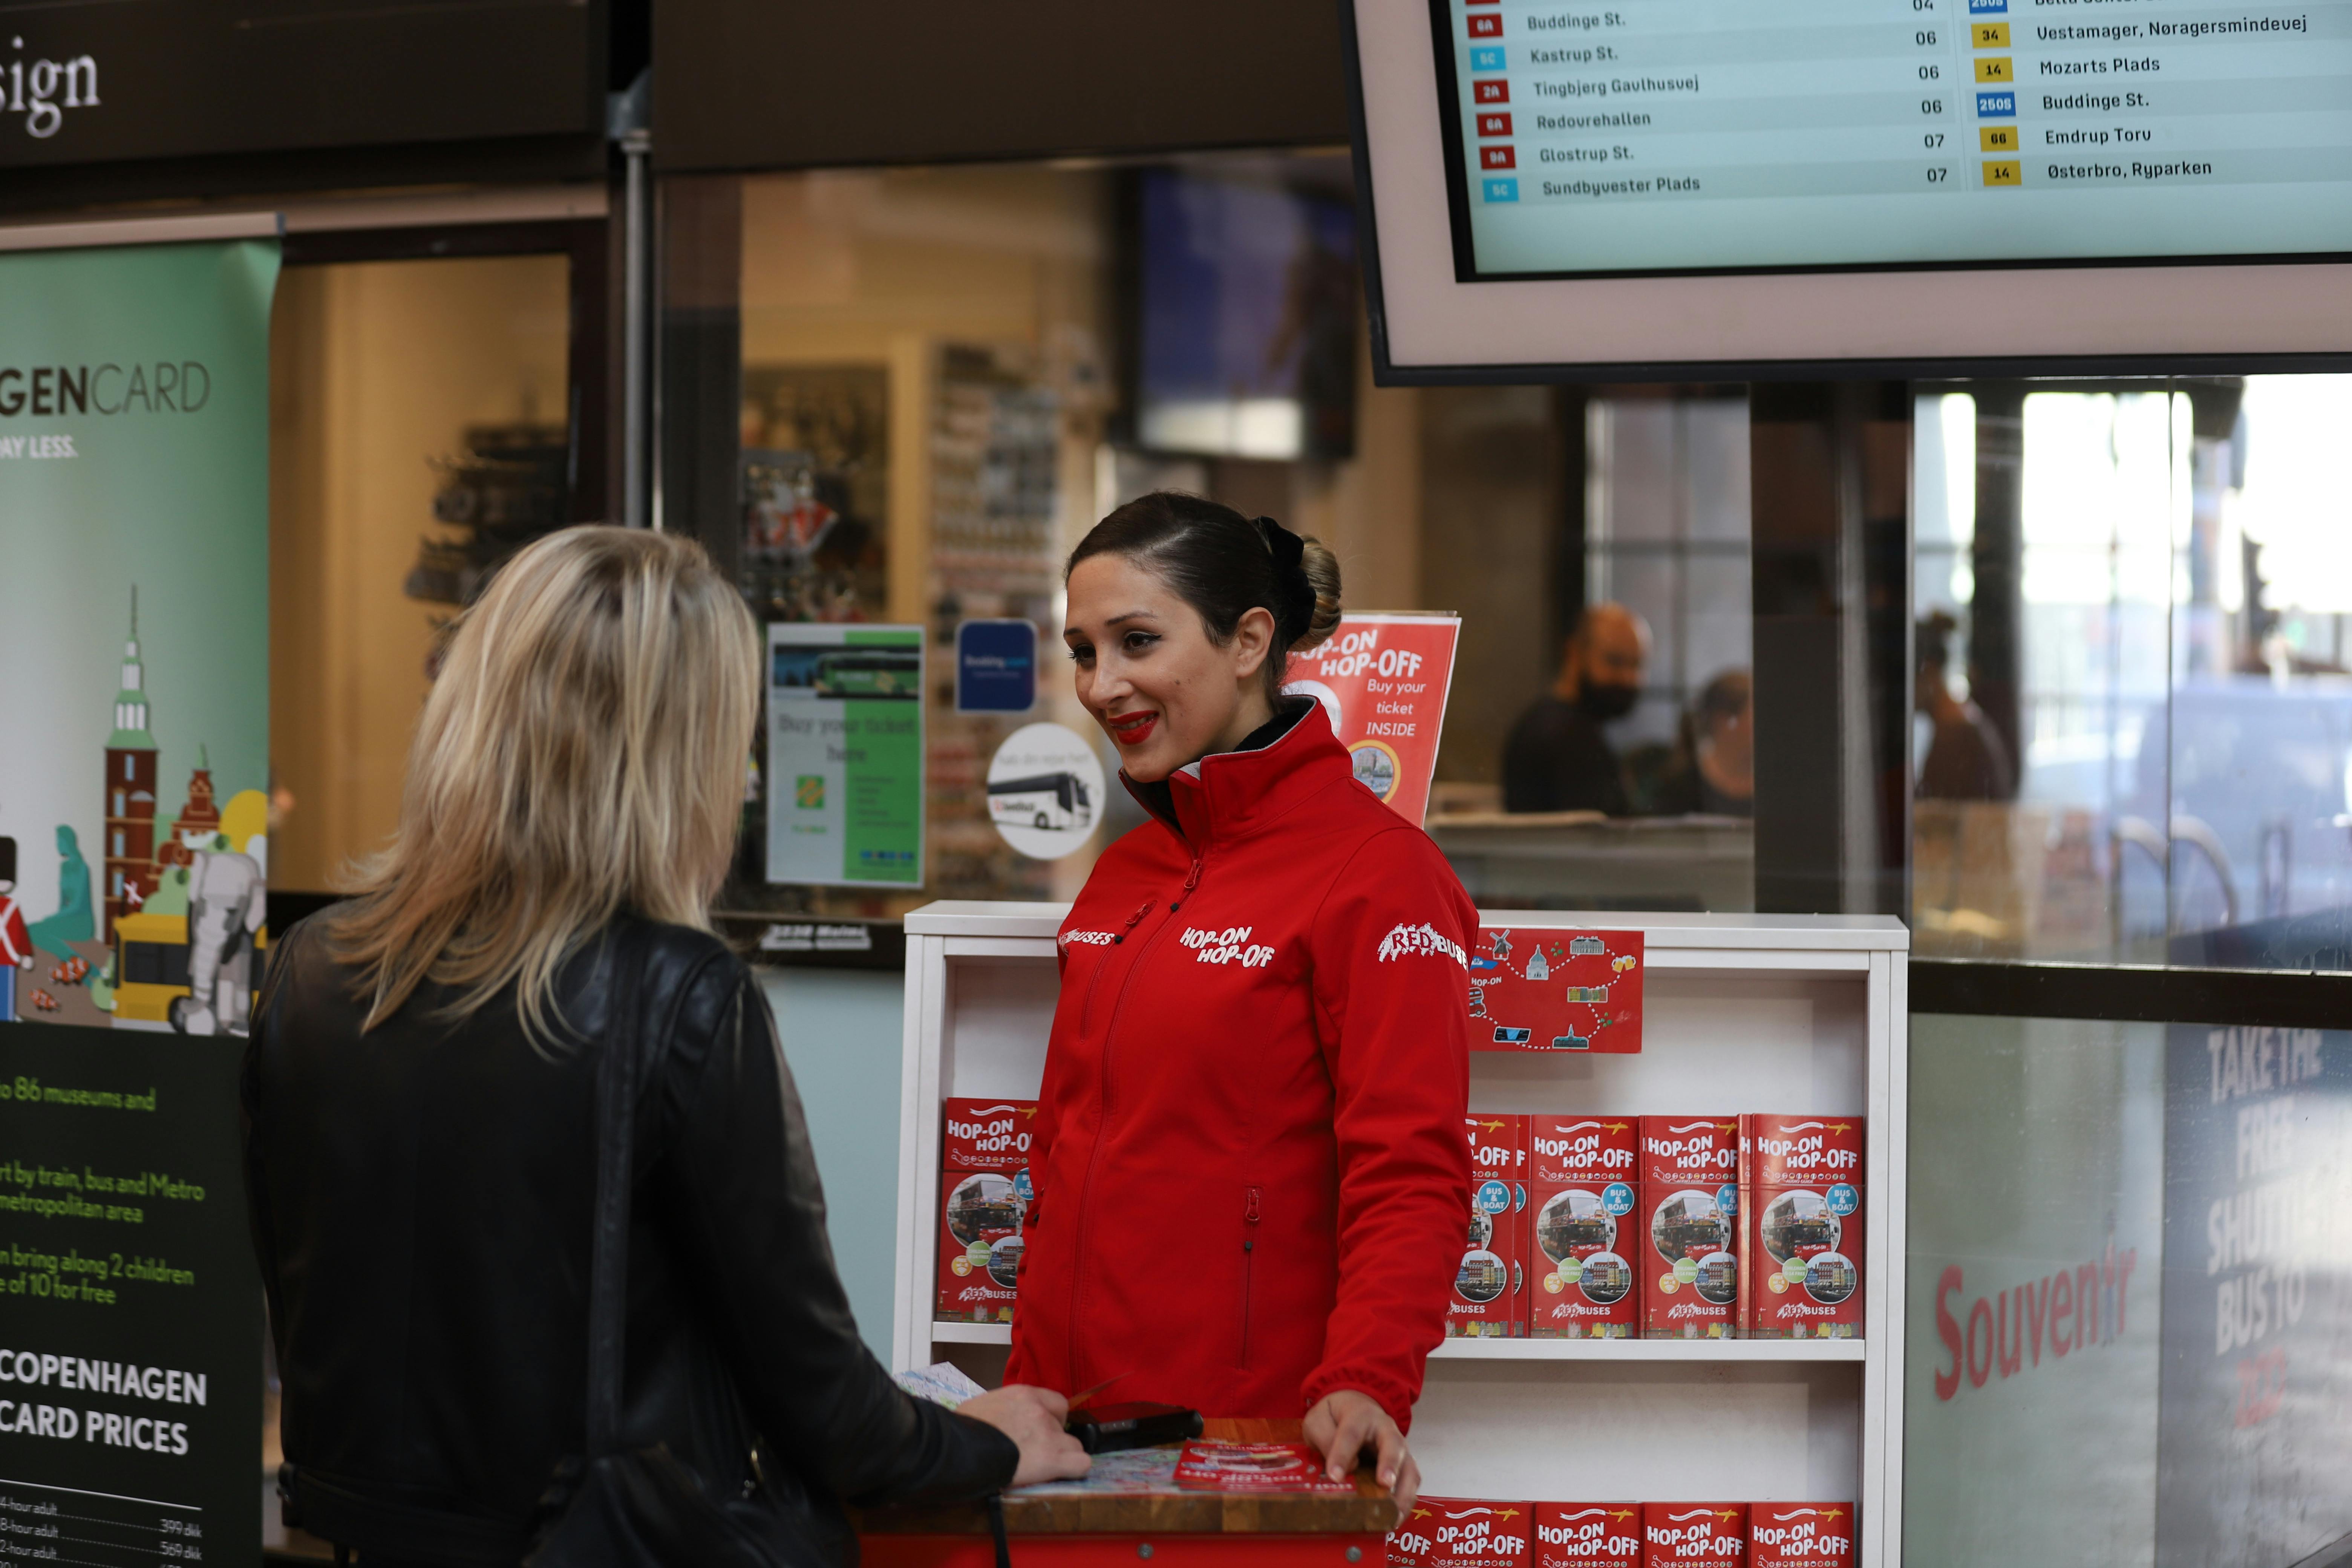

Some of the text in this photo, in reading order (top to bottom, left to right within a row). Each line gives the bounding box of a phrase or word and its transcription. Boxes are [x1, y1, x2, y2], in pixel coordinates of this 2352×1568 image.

[1527, 12, 1626, 31] Buddinge St.
[2037, 15, 2307, 40] Vestamager, Nøragersmindevej
[1916, 32, 1936, 45] 06
[1982, 30, 1998, 41] 34
[1480, 52, 1496, 65] 5C
[1531, 46, 1618, 63] Kastrup St.
[1919, 66, 1939, 80] 06
[1986, 64, 2001, 75] 14
[2041, 57, 2160, 75] Mozarts Plads
[1483, 85, 1500, 98] 2A
[1533, 80, 1606, 97] Tingbjerg
[1922, 100, 1942, 113] 06
[1980, 98, 2012, 112] 250S
[2043, 93, 2150, 111] Buddinge St.
[1924, 134, 1944, 148] 07
[1991, 133, 2007, 144] 66
[2046, 128, 2151, 145] Emdrup Torv
[1540, 145, 1634, 162] Glostrup St.
[1927, 168, 1947, 182] 07
[1994, 167, 2009, 179] 14
[2048, 161, 2212, 179] Østerbro, Ryparken
[1492, 184, 1508, 196] 5C
[1543, 176, 1700, 196] Sundbyvester Plads
[1320, 649, 1423, 677] HOP-OFF
[1367, 679, 1427, 695] Buy your
[1376, 701, 1414, 715] ticket
[1366, 722, 1417, 737] INSIDE
[1179, 926, 1253, 949] HOP-ON
[1196, 944, 1276, 968] HOP-OFF
[1436, 935, 1468, 973] BUSE
[1471, 976, 1502, 987] HOP-ON
[2207, 1026, 2323, 1104] TAKE THE
[14, 1076, 156, 1112] 86 museums and
[947, 1118, 1014, 1139] HOP-ON
[976, 1132, 1032, 1152] HOP-O
[1534, 1134, 1600, 1156] HOP-ON
[1648, 1134, 1713, 1157] HOP-ON
[1758, 1135, 1822, 1156] HOP-ON
[1563, 1148, 1634, 1168] HOP-OFF
[1787, 1148, 1857, 1168] HOP-OFF
[14, 1159, 36, 1189] by
[38, 1165, 83, 1192] train,
[84, 1165, 114, 1192] bus
[116, 1172, 147, 1195] and
[149, 1172, 205, 1201] Metro
[106, 1205, 144, 1223] area
[12, 1243, 58, 1275] bring
[60, 1248, 109, 1281] along
[110, 1253, 124, 1277] 2
[124, 1255, 195, 1286] children
[8, 1271, 26, 1295] of
[28, 1272, 52, 1297] 10
[53, 1275, 79, 1300] for
[80, 1277, 117, 1305] free
[986, 1291, 1017, 1299] BUSES
[1454, 1305, 1485, 1314] BUSES
[1579, 1307, 1611, 1315] BUSES
[1695, 1307, 1726, 1315] BUSES
[1805, 1307, 1836, 1315] BUSES
[2216, 1265, 2269, 1356] BUS
[0, 1349, 207, 1406] COPENHAGEN
[0, 1400, 189, 1456] CARD PRICES
[159, 1519, 183, 1535] 399
[1538, 1522, 1605, 1545] HOP-ON
[1647, 1522, 1711, 1545] HOP-ON
[1753, 1521, 1815, 1545] HOP-ON
[1452, 1535, 1525, 1555] HOP-OFF
[1567, 1536, 1639, 1556] HOP-OFF
[1676, 1536, 1743, 1557] HOP-OFF
[1780, 1535, 1849, 1556] HOP-OFF
